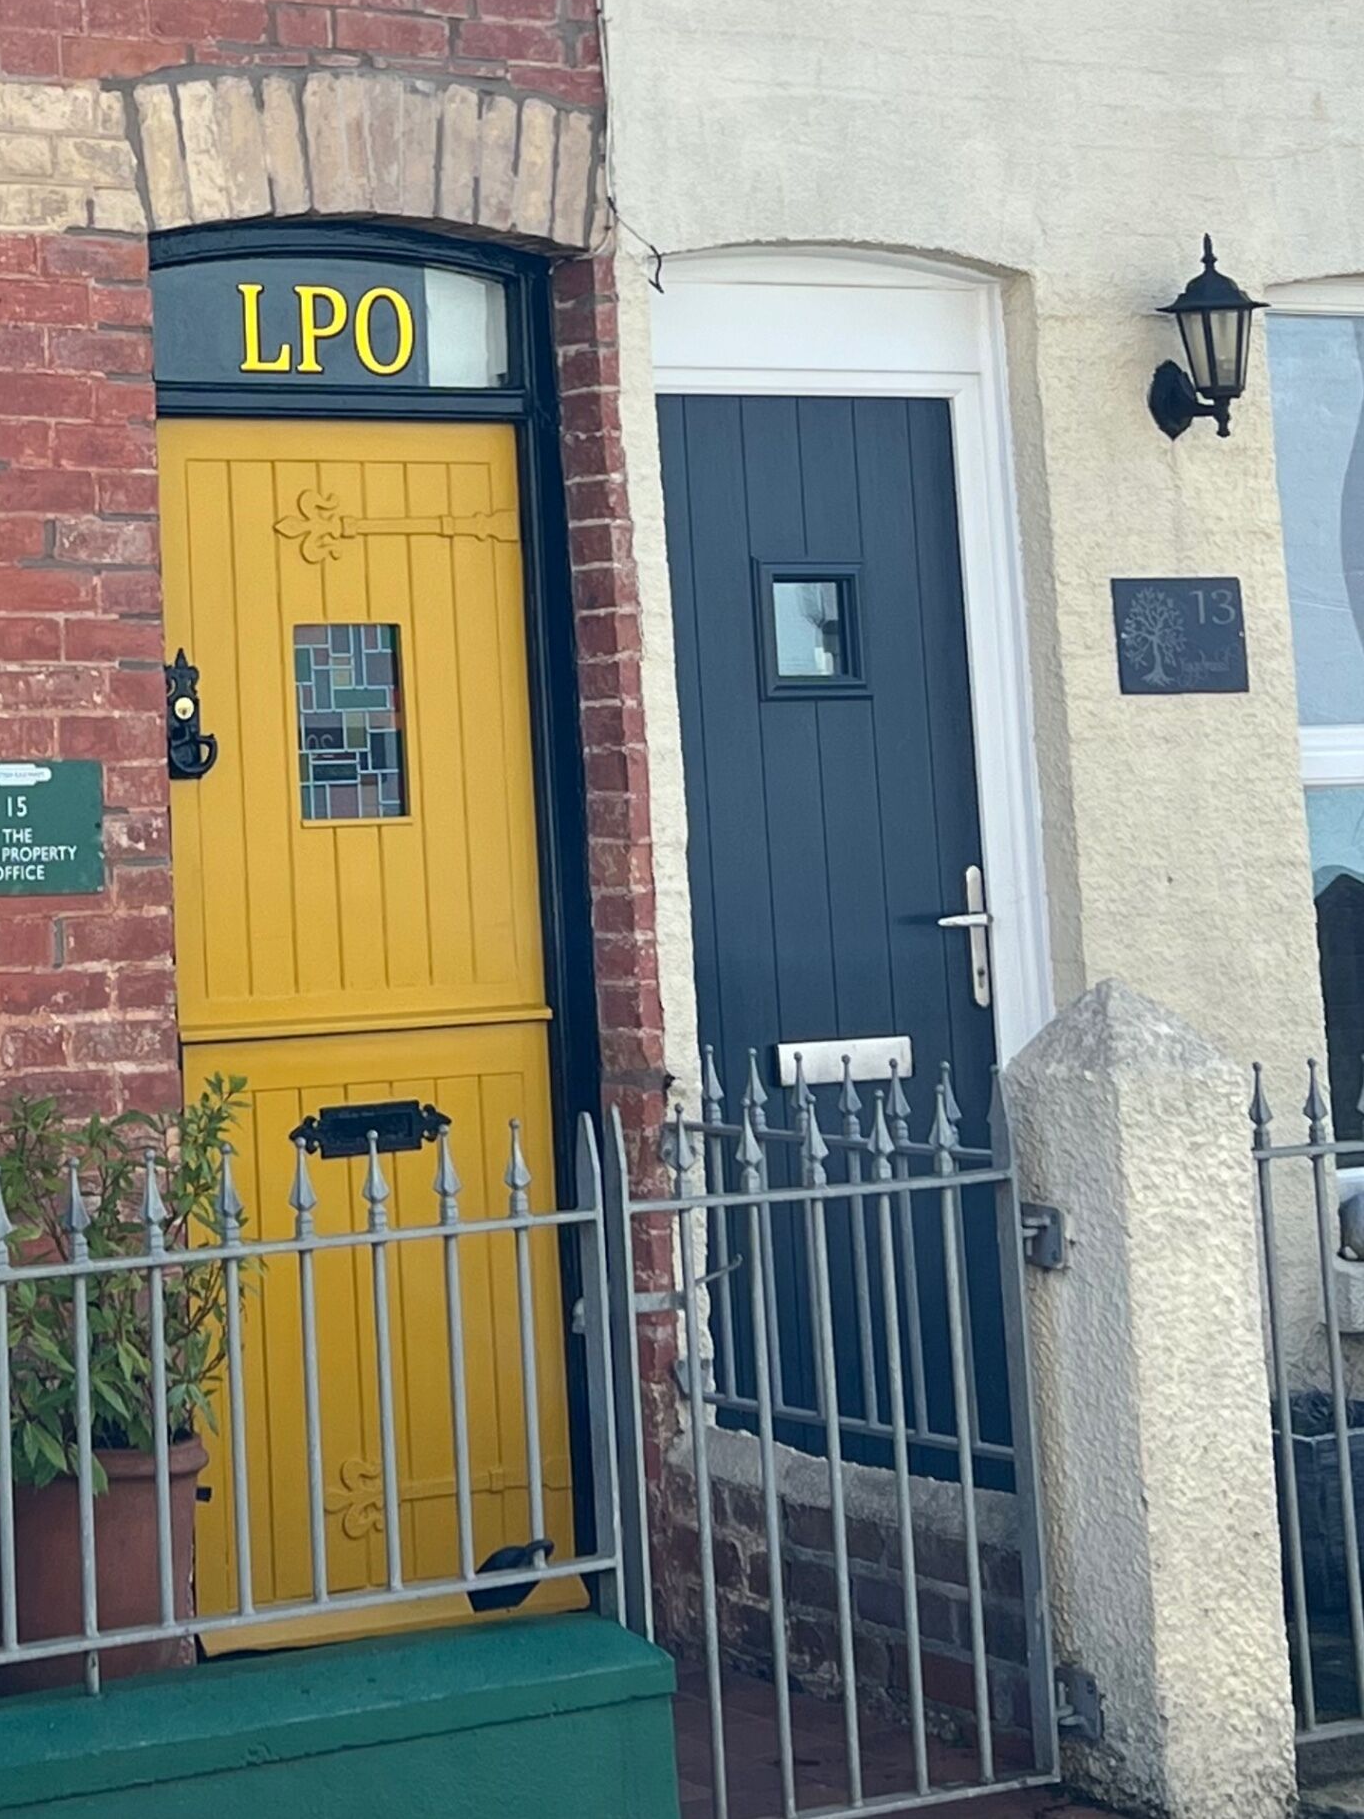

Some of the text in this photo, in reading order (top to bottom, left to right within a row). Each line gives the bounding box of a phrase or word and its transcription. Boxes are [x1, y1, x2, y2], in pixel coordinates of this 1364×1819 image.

[237, 283, 415, 375] LPO
[1189, 589, 1236, 625] 13
[7, 796, 27, 817] 15
[2, 828, 33, 844] THE
[2, 845, 77, 863] PROPERTY
